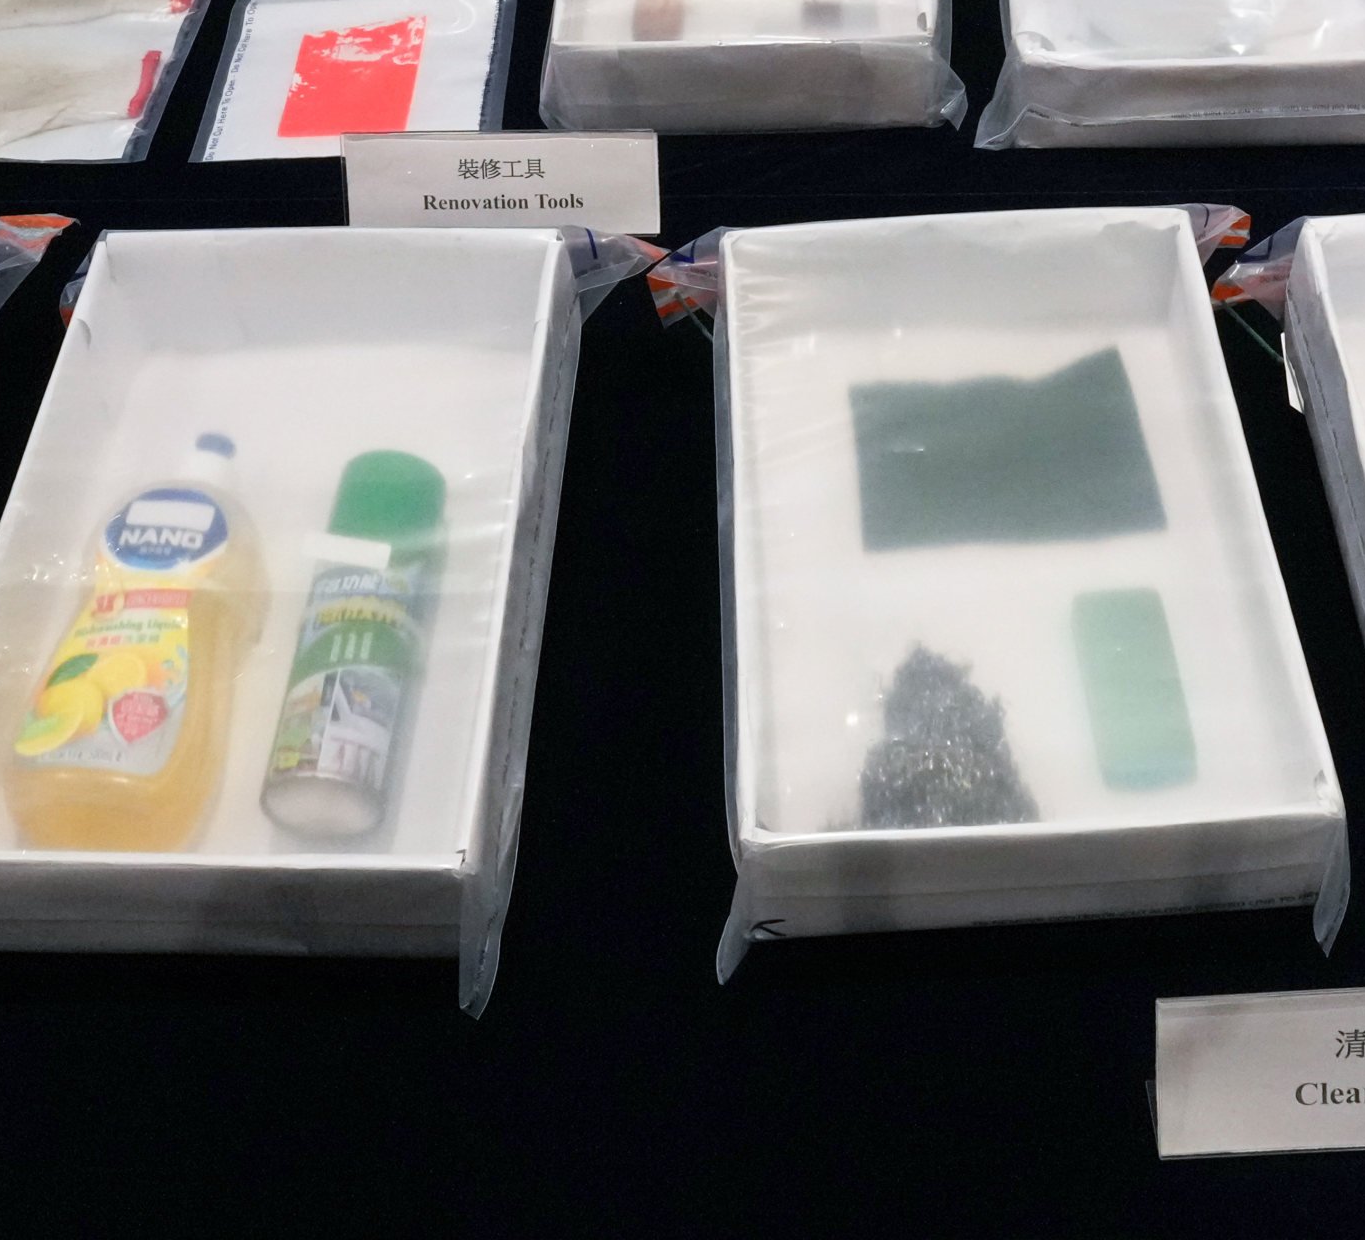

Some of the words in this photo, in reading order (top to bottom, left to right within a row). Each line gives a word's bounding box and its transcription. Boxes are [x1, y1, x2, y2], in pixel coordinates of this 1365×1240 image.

[458, 159, 545, 179] 裝修工具
[424, 194, 528, 210] Renovation
[535, 194, 583, 209] Tools
[118, 526, 204, 550] NANO
